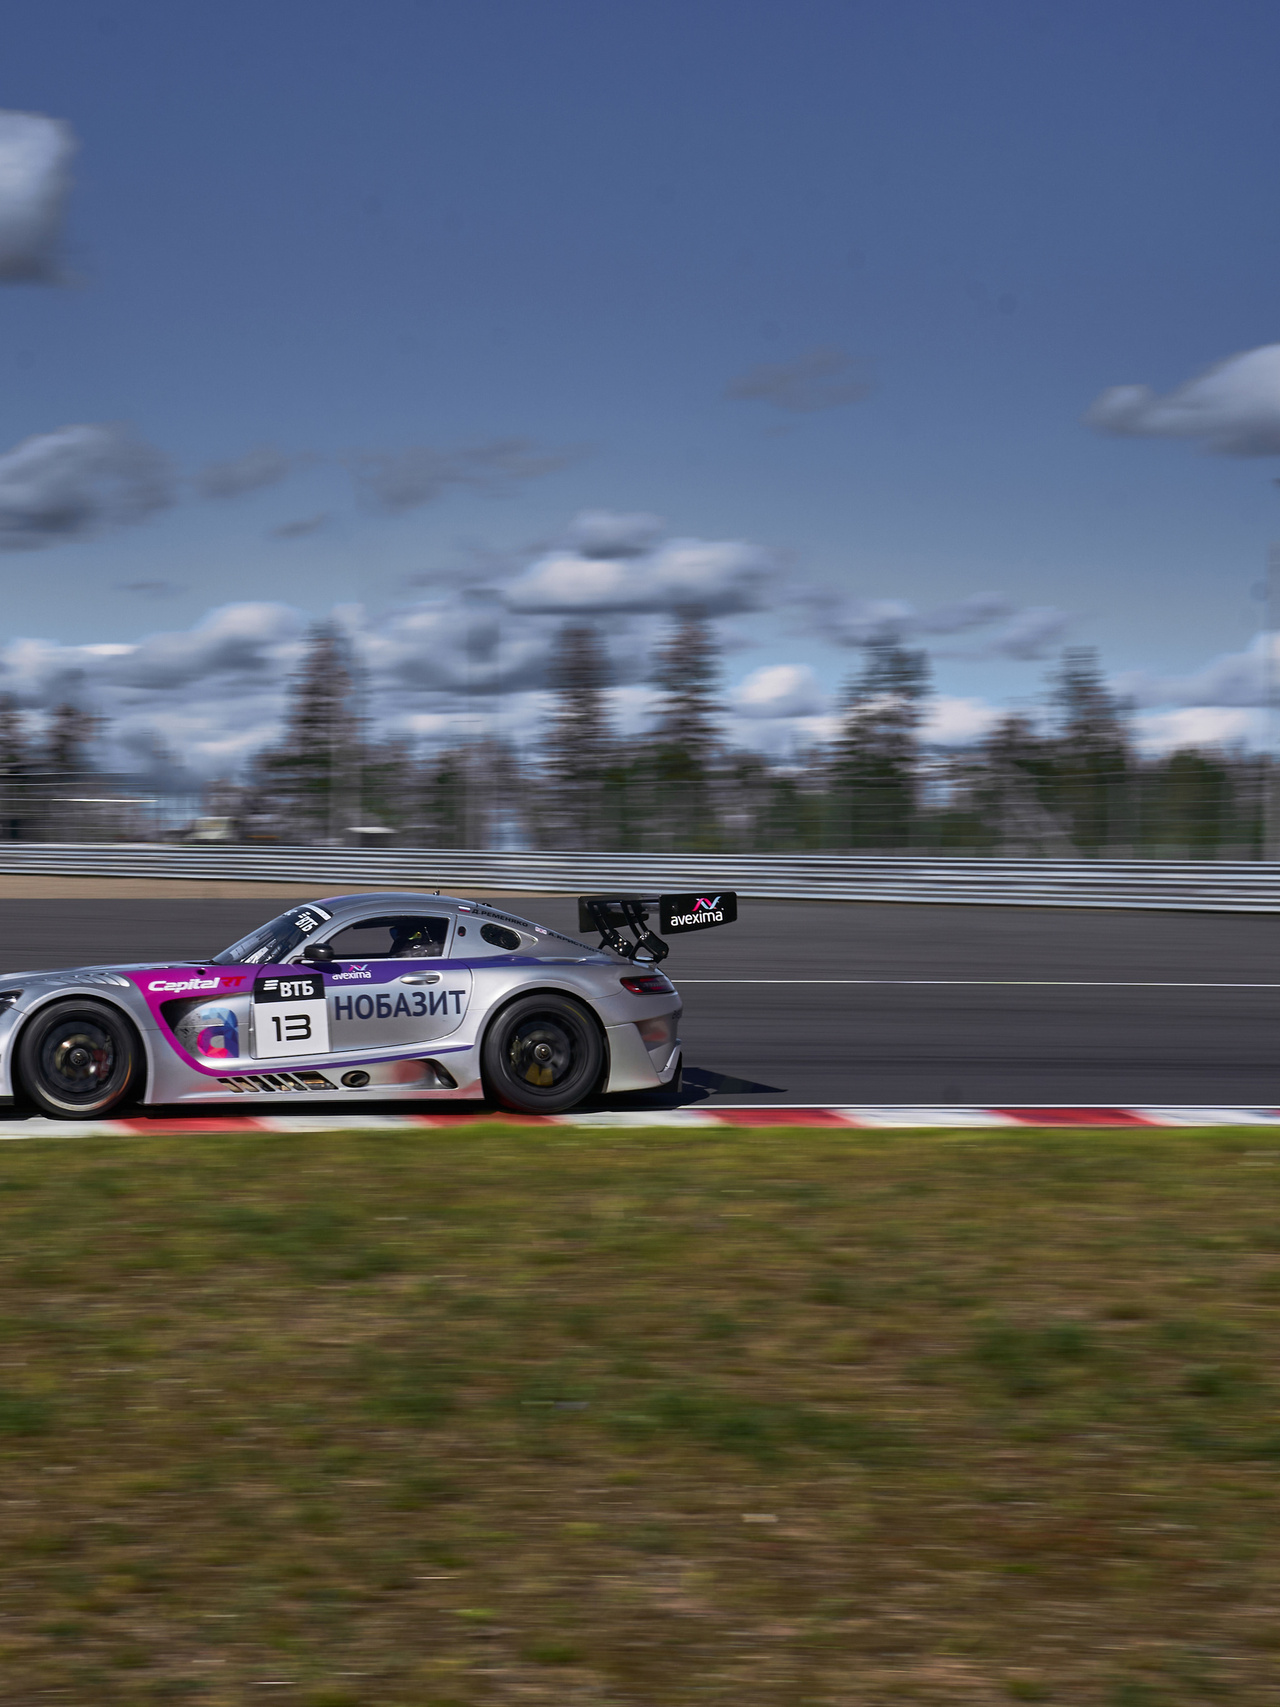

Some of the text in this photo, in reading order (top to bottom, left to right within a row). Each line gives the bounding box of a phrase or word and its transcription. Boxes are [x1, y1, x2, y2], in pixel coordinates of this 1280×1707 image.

[295, 916, 318, 932] ВТБ
[670, 910, 723, 926] avexima
[332, 970, 372, 980] avexima
[279, 980, 314, 997] ВТБ
[334, 990, 466, 1020] НОБАЗИТ
[272, 1014, 312, 1042] 13
